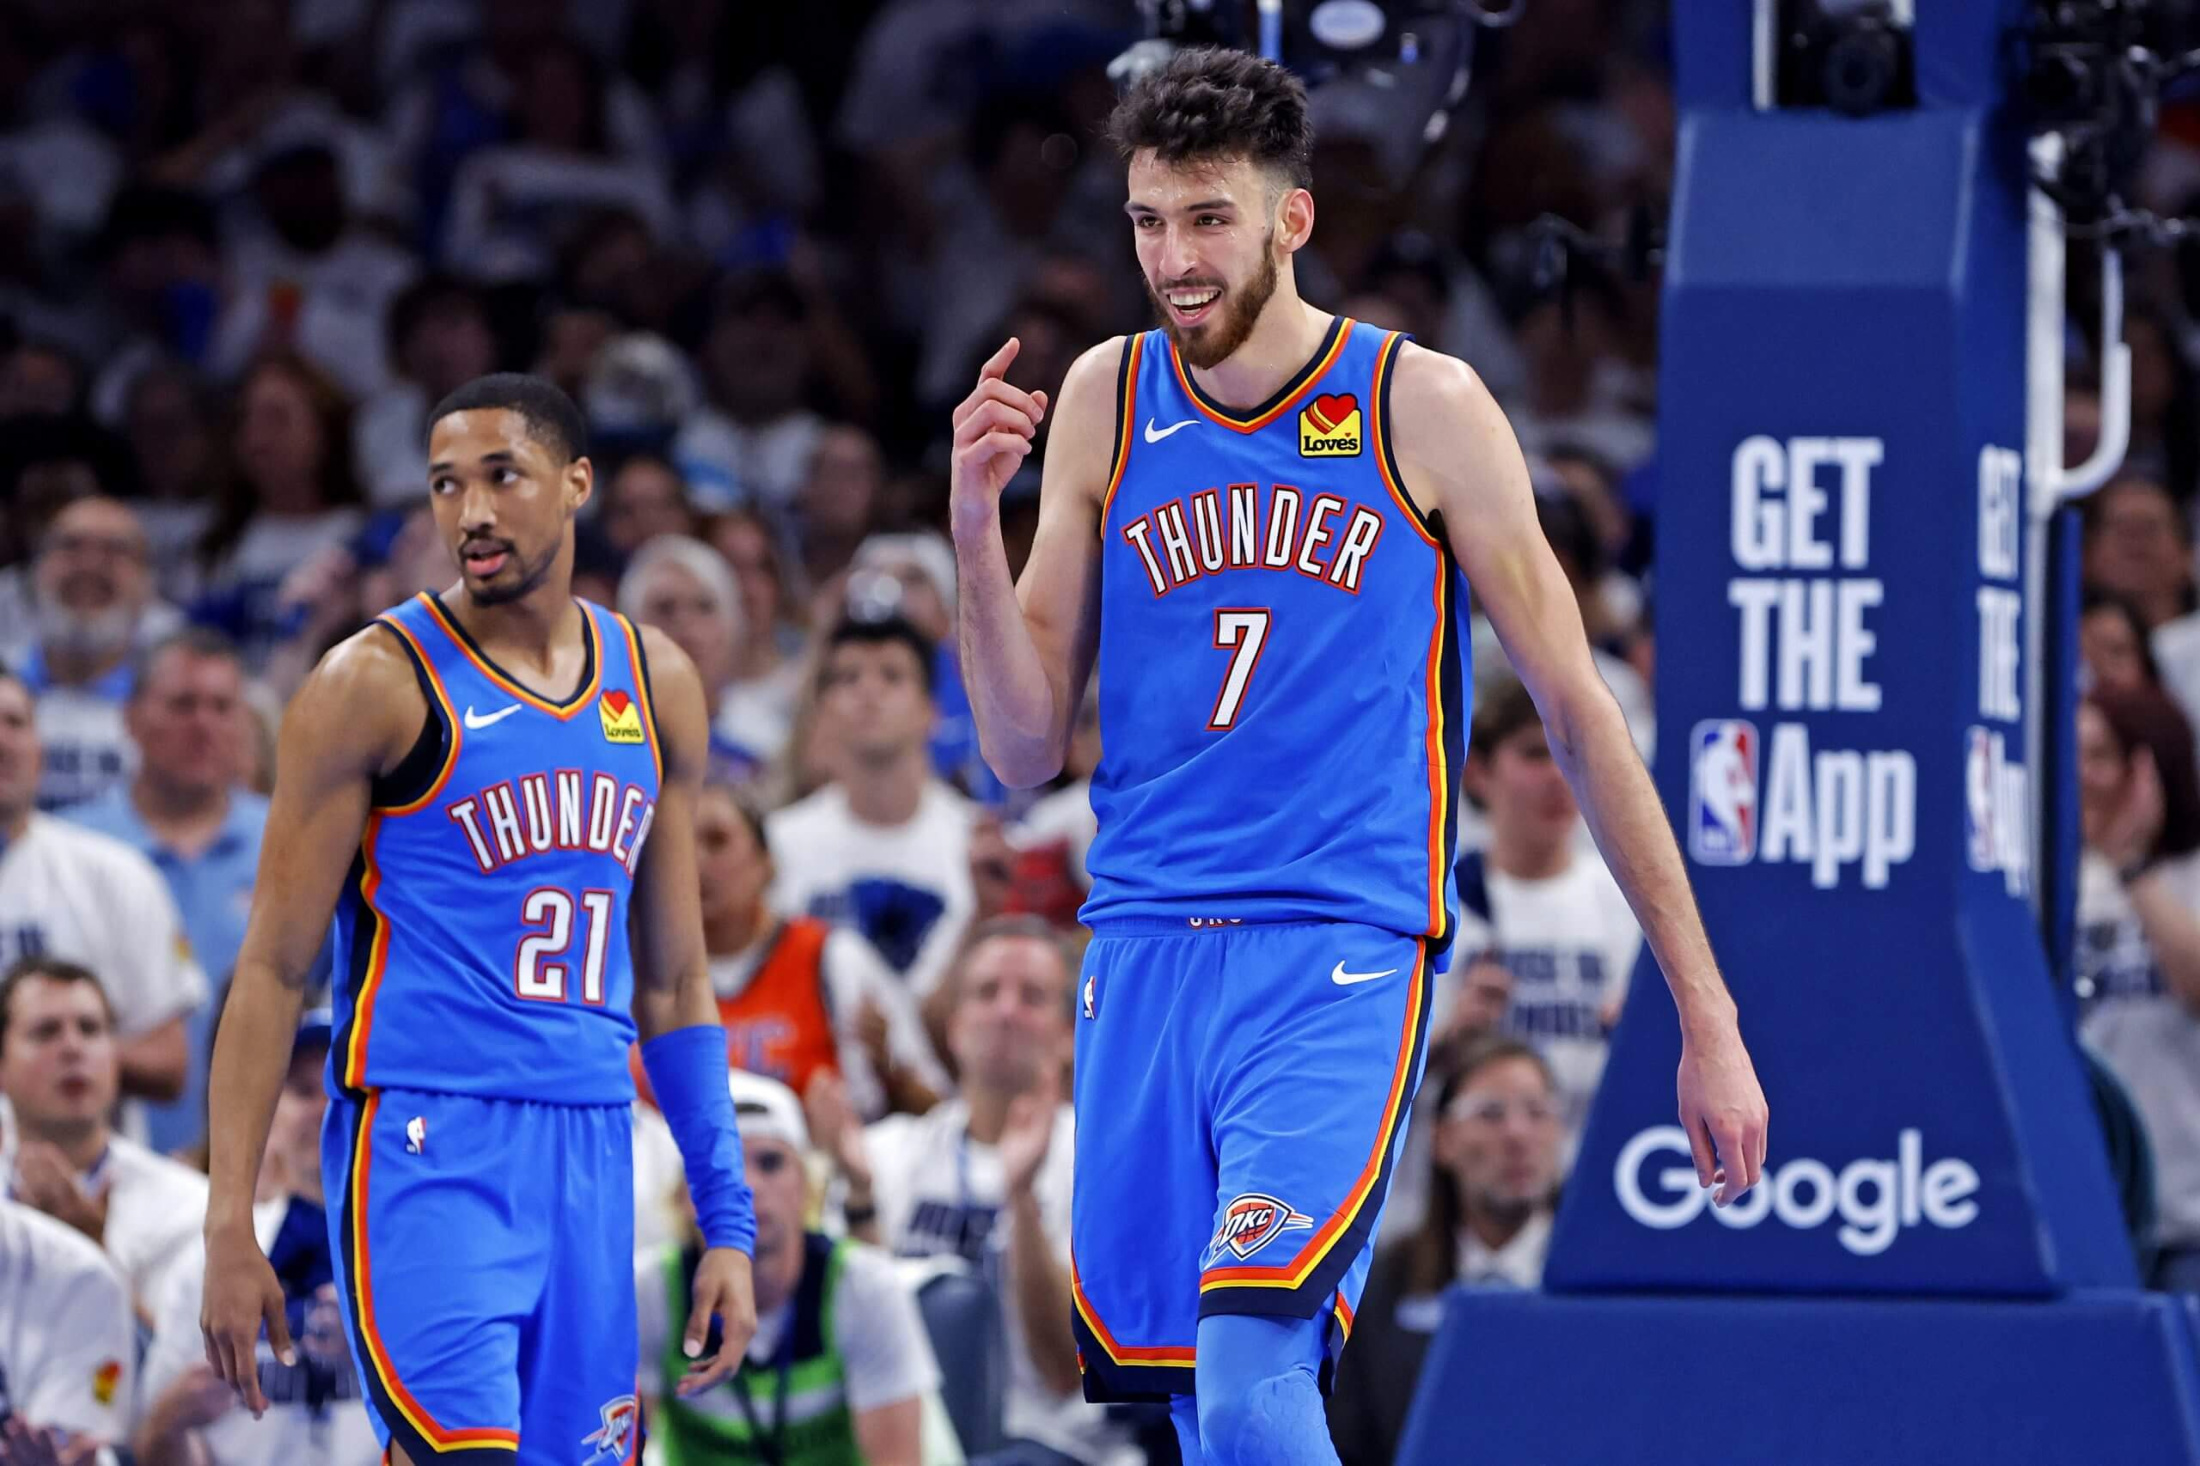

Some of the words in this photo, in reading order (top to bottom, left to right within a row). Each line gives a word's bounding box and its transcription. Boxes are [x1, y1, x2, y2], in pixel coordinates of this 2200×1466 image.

[1121, 482, 1386, 599] THUNDER
[1731, 435, 1885, 571] GET
[1204, 607, 1272, 732] 7
[1727, 578, 1884, 712] THE
[1759, 722, 1917, 890] App
[514, 886, 614, 1005] 21
[1218, 1208, 1273, 1249] OKC
